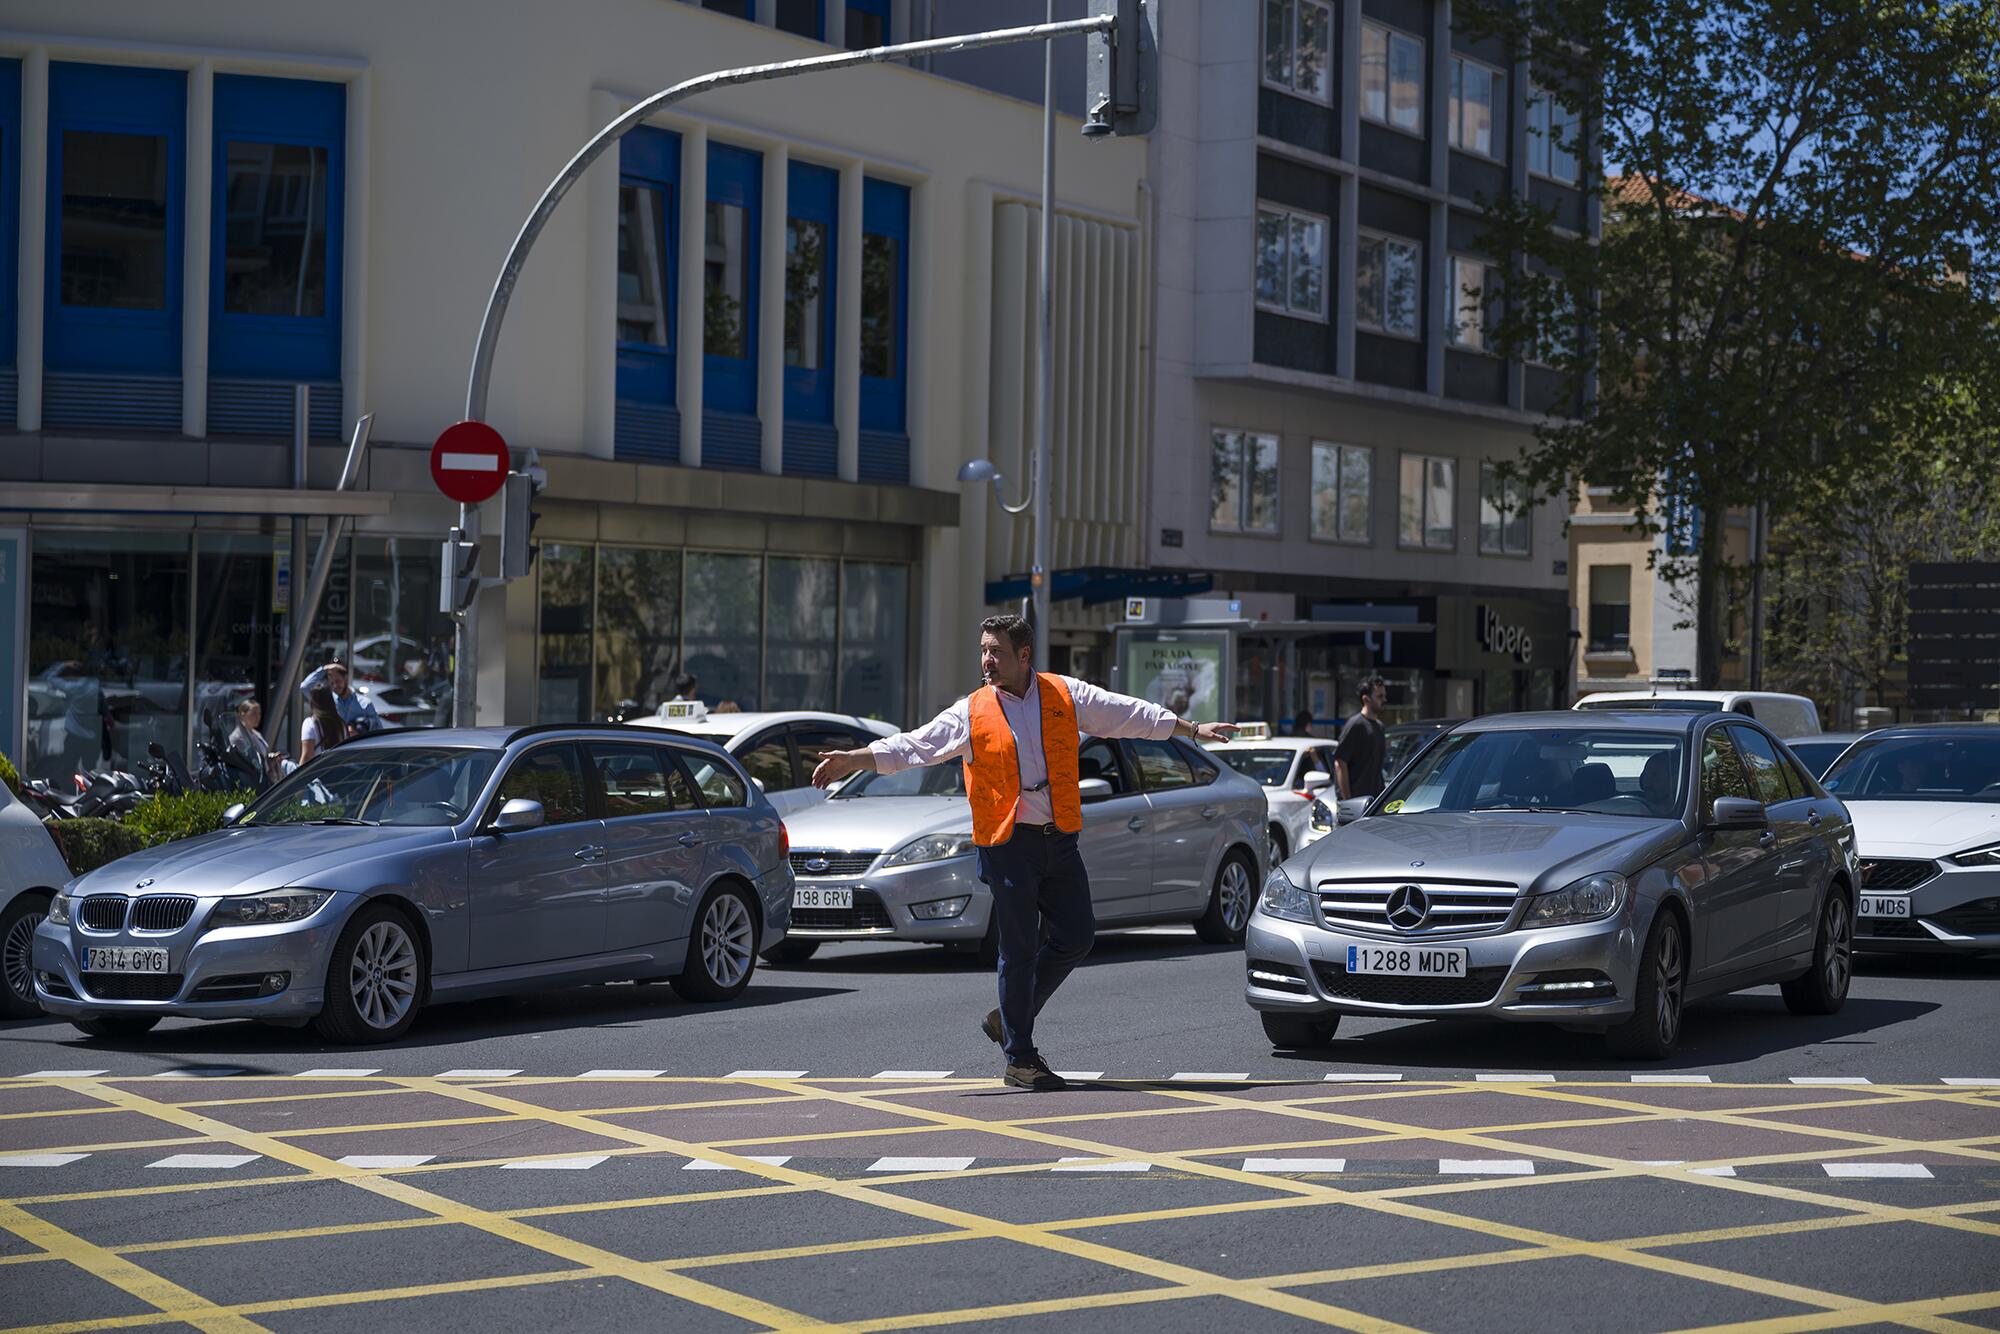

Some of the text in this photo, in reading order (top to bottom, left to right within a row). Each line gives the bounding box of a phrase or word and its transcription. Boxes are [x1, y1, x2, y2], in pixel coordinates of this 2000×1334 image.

[1152, 649, 1193, 659] PRADA
[796, 890, 849, 906] 198 GRV
[1875, 898, 1906, 915] MDS
[89, 949, 162, 971] 7314 GYG
[1362, 949, 1460, 973] 1288 MDR
